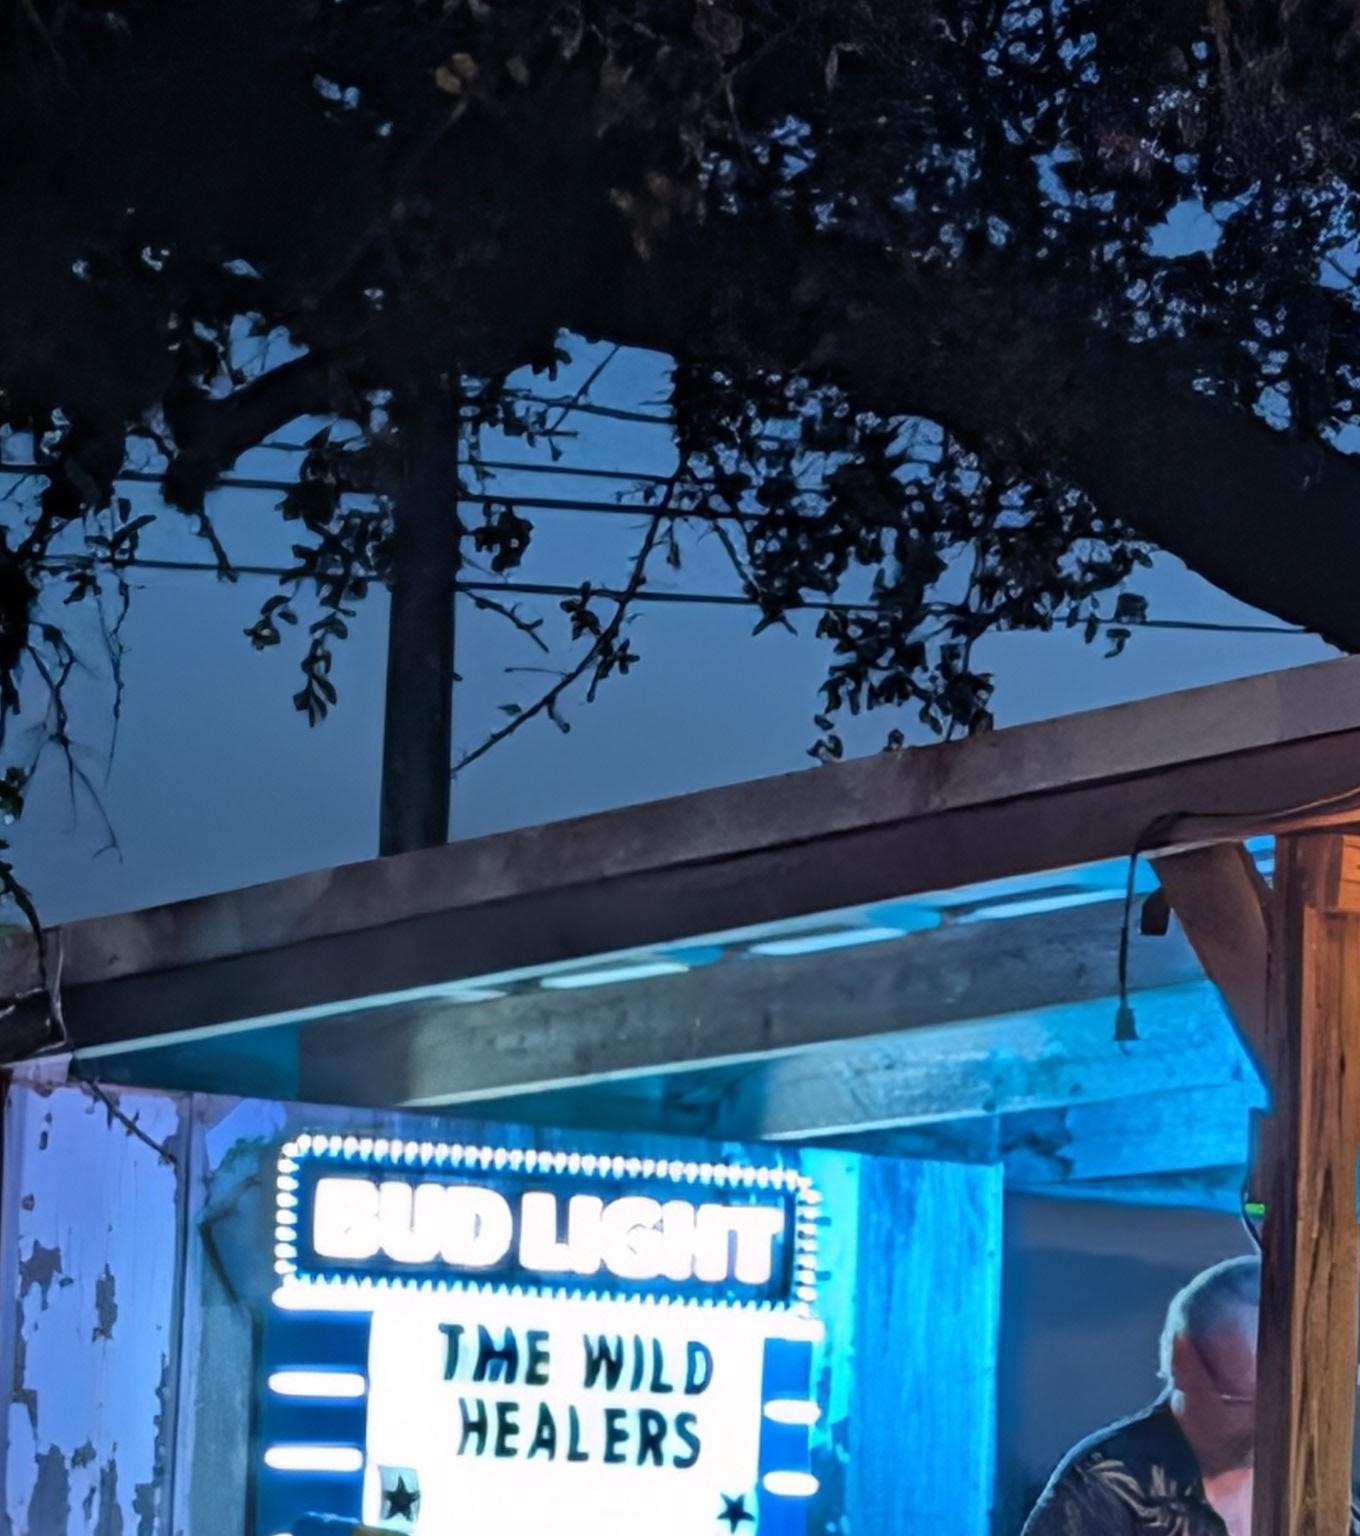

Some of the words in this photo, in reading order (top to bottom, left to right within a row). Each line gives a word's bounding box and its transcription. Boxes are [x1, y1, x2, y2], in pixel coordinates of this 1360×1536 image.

[313, 1178, 512, 1267] BUD
[519, 1192, 784, 1284] LIGHT
[438, 1323, 551, 1386] THE
[584, 1334, 714, 1396] WILD
[457, 1396, 702, 1469] HEALERS
